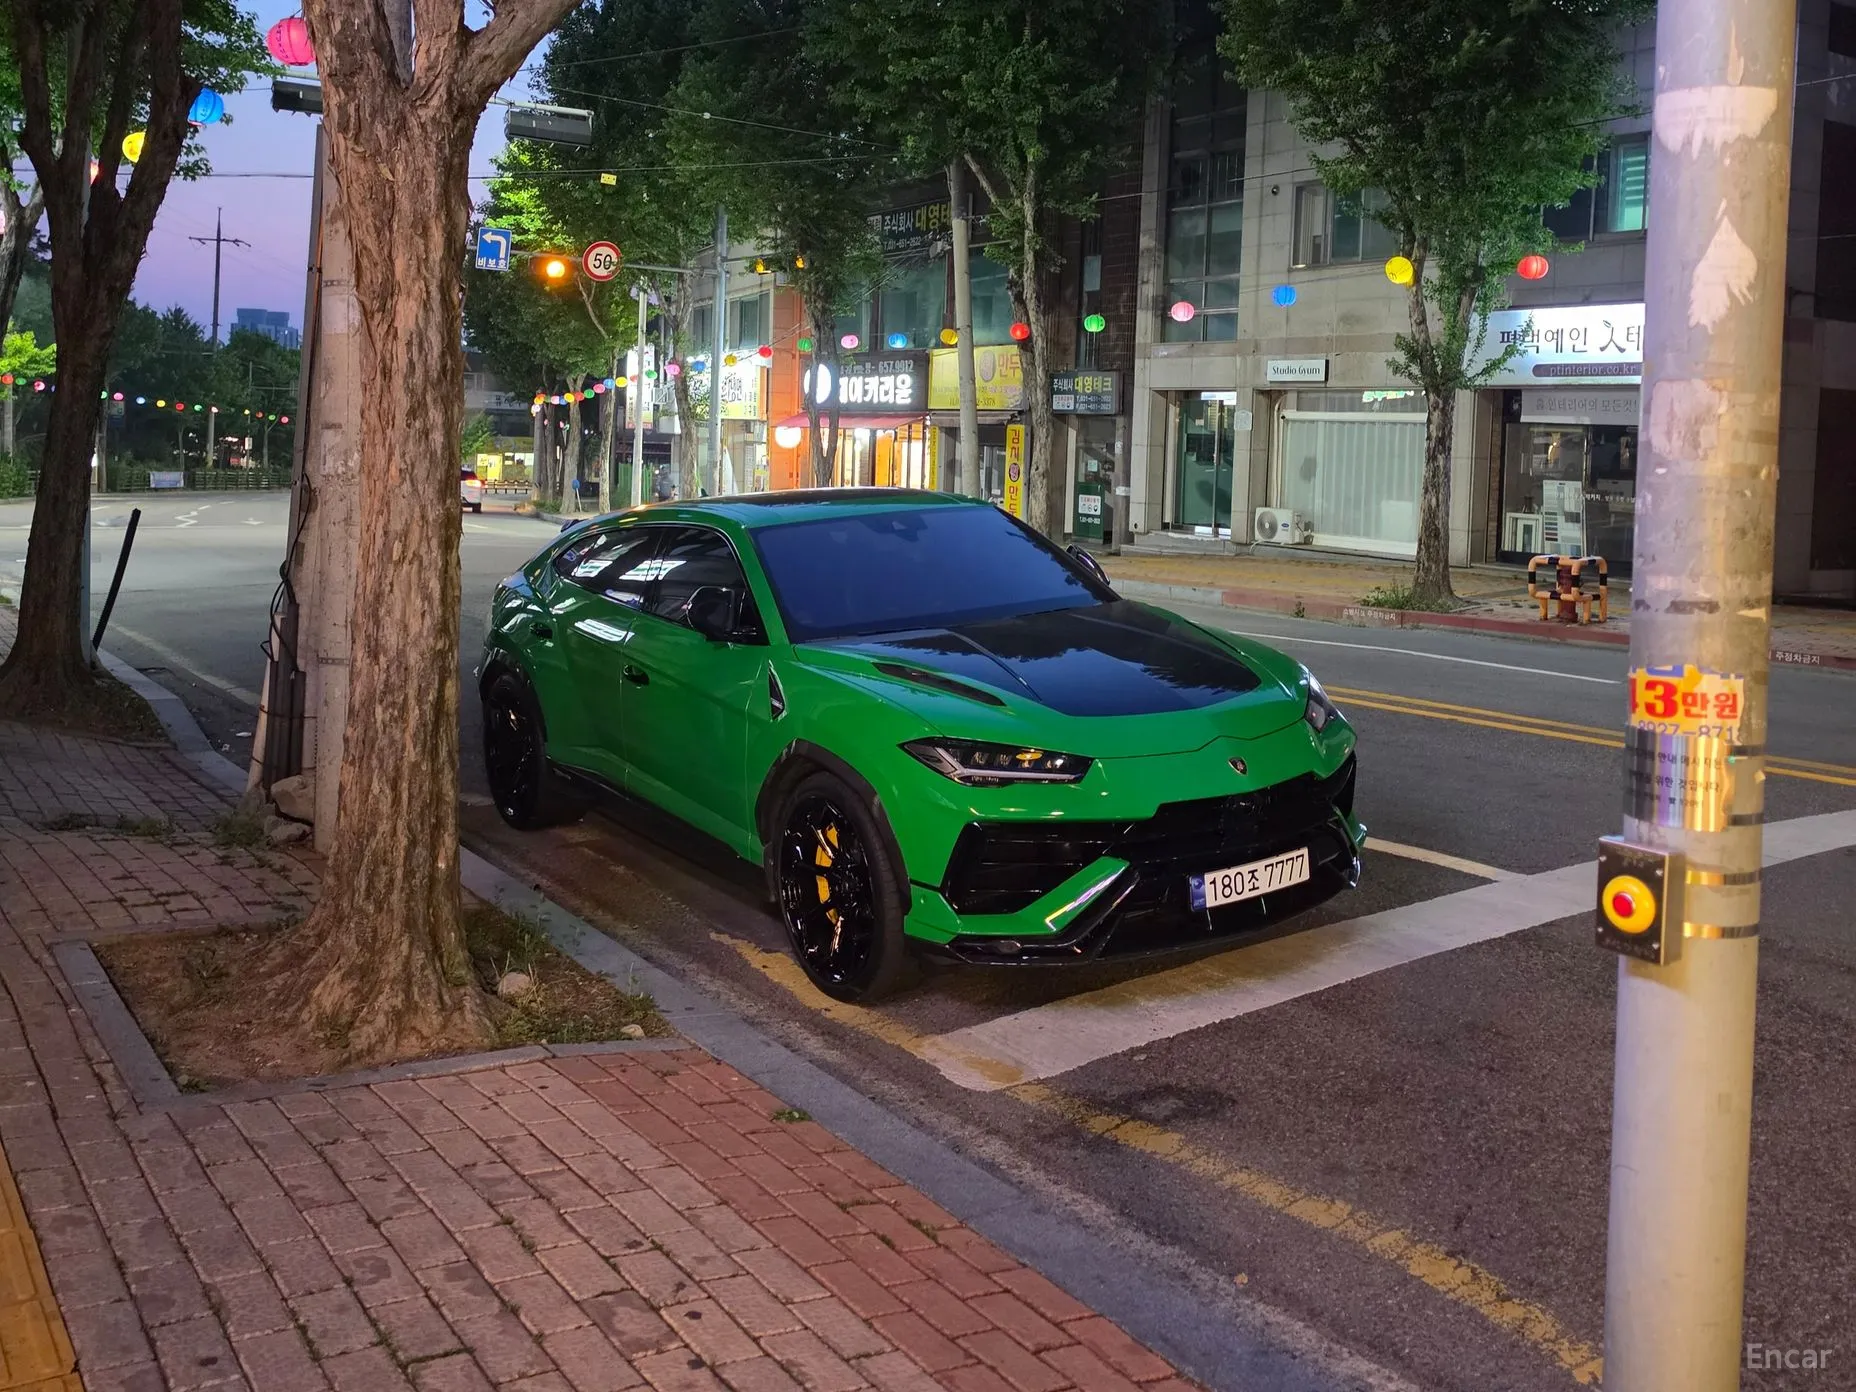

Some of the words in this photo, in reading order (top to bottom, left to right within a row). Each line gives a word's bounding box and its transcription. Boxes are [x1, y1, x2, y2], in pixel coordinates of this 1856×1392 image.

[883, 210, 914, 235] 주식회사
[477, 257, 507, 269] 비보호
[593, 253, 612, 270] 50
[998, 352, 1020, 378] 만두
[1272, 365, 1297, 376] Studio
[1299, 365, 1320, 377] Gyum
[1550, 364, 1637, 377] ptinterior.co.kr
[1053, 378, 1073, 392] 주식회사
[1074, 376, 1113, 393] 대영테크
[1775, 651, 1820, 664] 주정차금지
[1209, 869, 1260, 902] 180조
[1264, 854, 1305, 889] 7777
